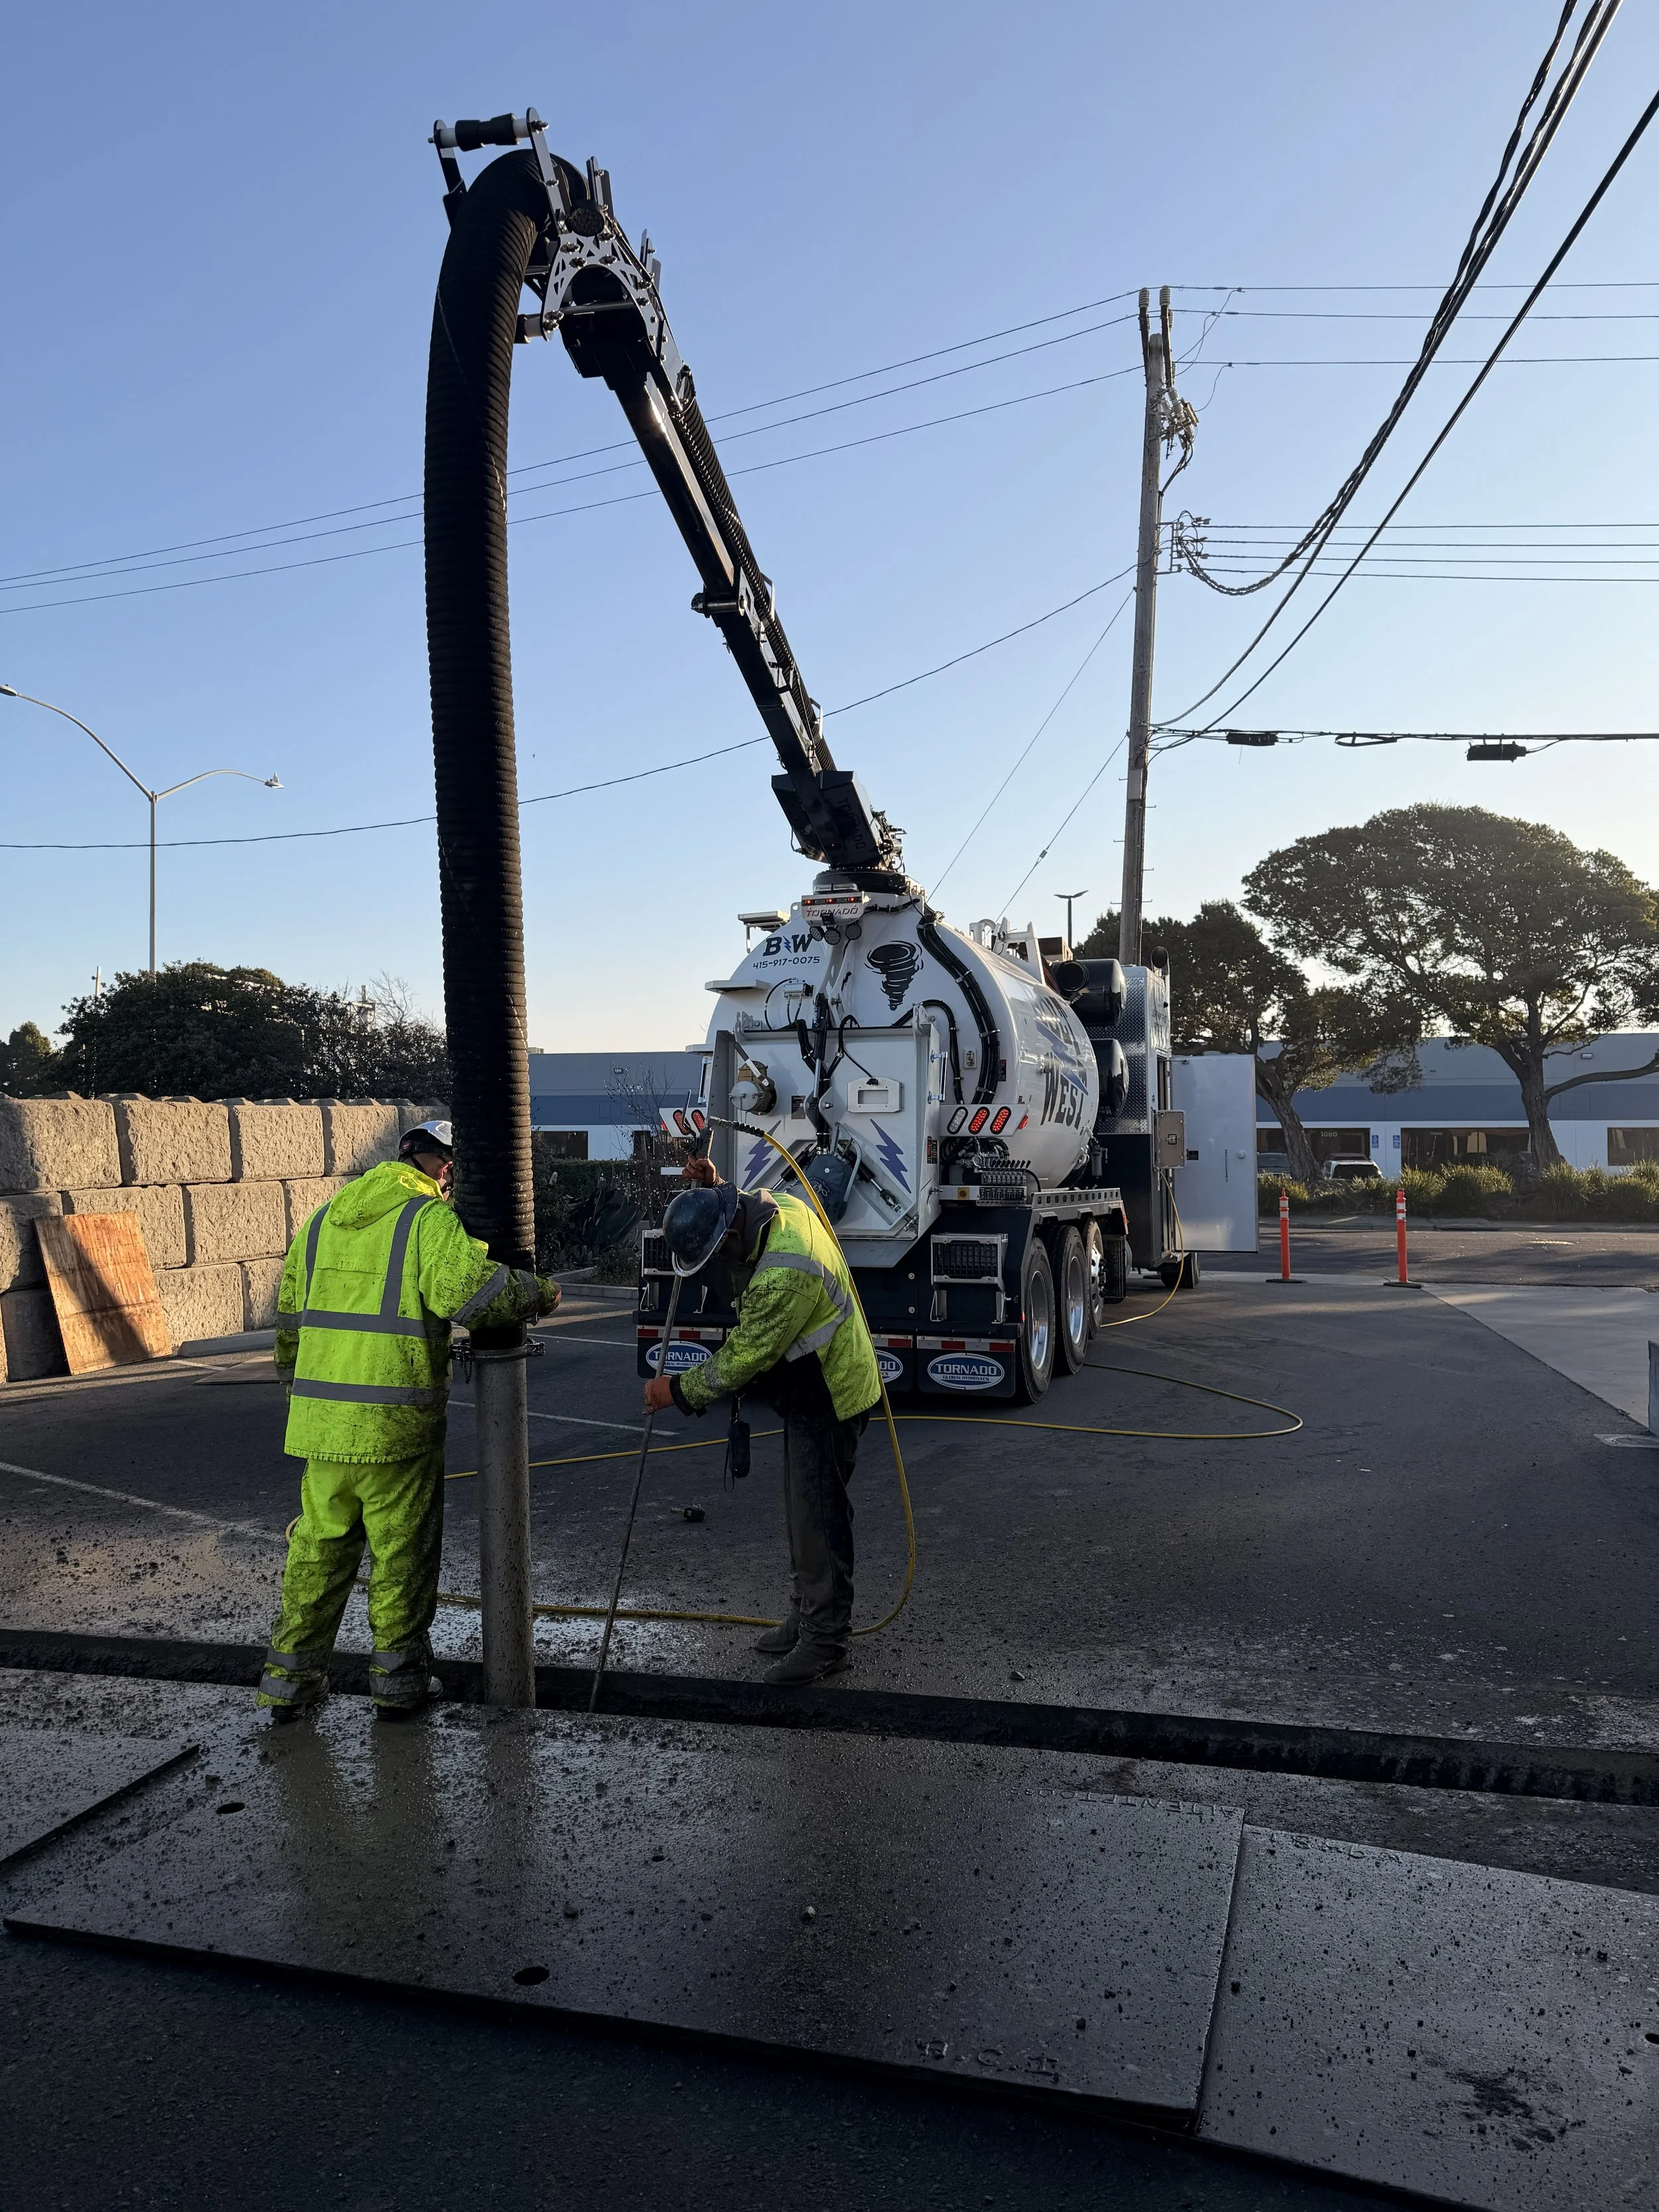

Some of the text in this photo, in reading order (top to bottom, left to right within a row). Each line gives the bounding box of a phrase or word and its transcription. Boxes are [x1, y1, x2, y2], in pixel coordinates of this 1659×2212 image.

[753, 956, 820, 969] 415-917-0075
[1041, 1052, 1087, 1136] WEST
[653, 1351, 707, 1362] TRNADO
[936, 1364, 997, 1375] TORNADO
